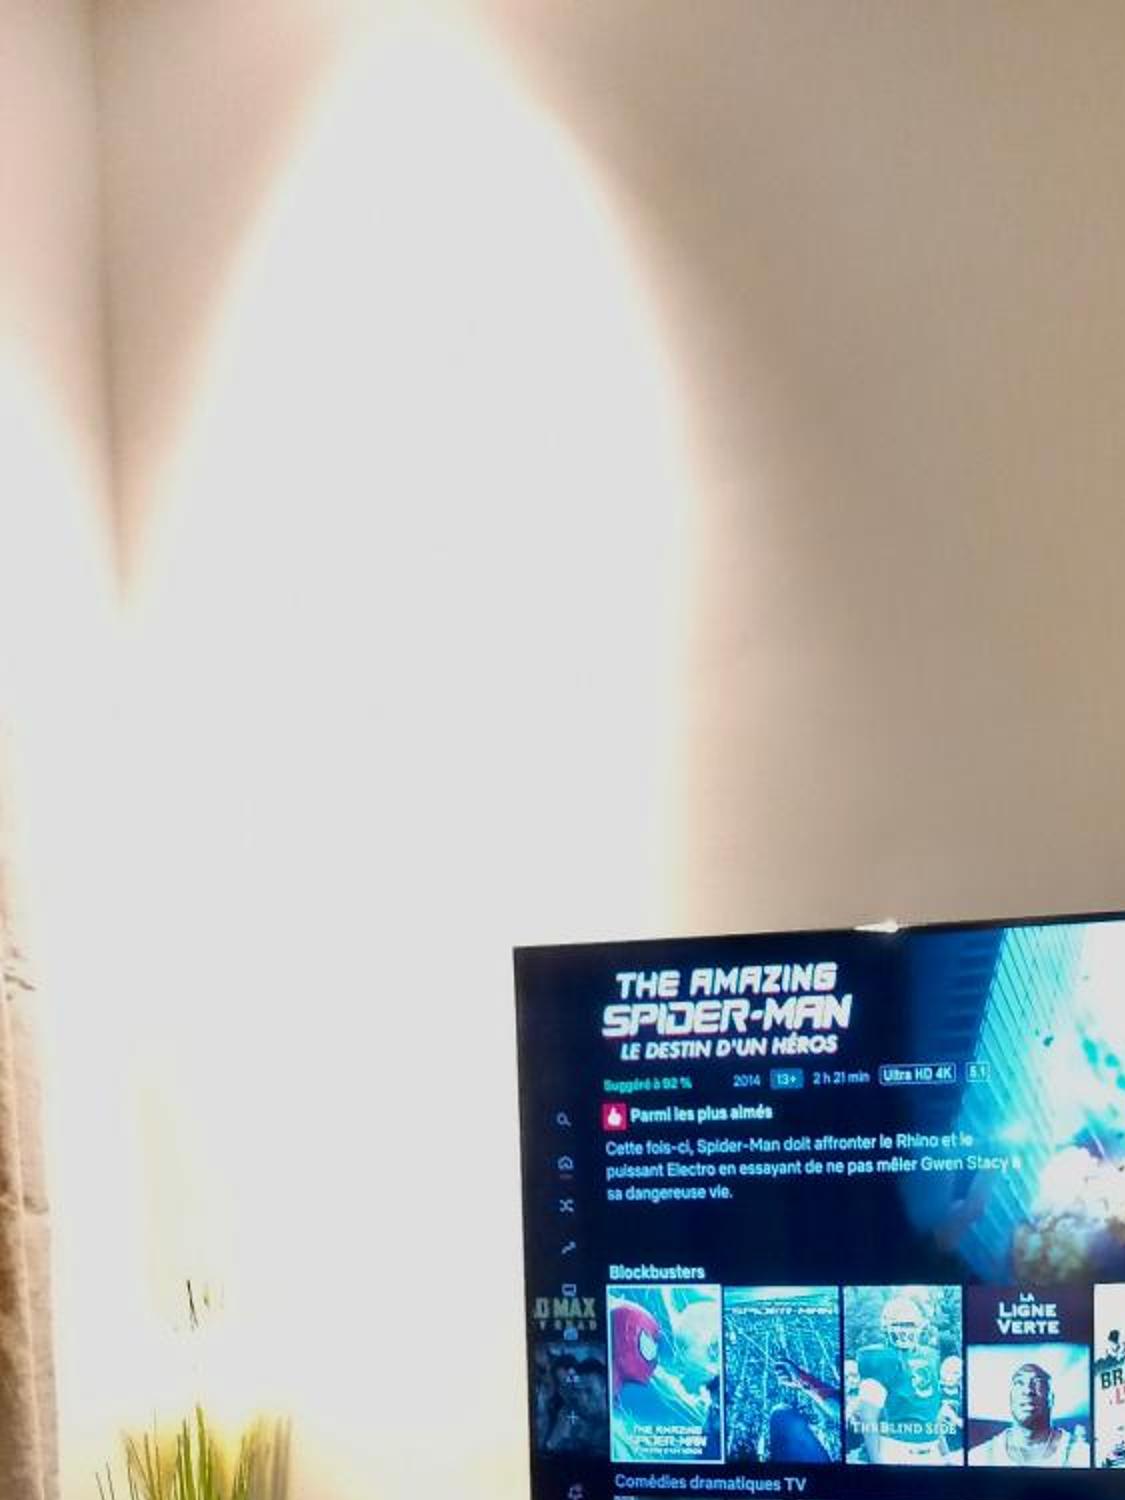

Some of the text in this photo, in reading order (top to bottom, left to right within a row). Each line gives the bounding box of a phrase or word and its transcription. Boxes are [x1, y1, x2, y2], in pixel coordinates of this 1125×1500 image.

[616, 962, 838, 999] THE AMAZING
[602, 994, 852, 1037] SPIDER-MAN
[621, 1031, 838, 1060] LE DESTIN D'UN HÉROS
[733, 1073, 761, 1088] 2014
[776, 1073, 797, 1085] 13+
[848, 1069, 871, 1083] min
[883, 1068, 912, 1082] Ultra
[915, 1067, 933, 1081] HD
[935, 1066, 952, 1080] 4K
[630, 1103, 773, 1124] Parmi les plus aimés
[605, 1141, 643, 1156] Cette
[697, 1137, 781, 1156] Spider-Man
[783, 1136, 811, 1151] doit
[814, 1134, 876, 1151] affronter
[879, 1132, 892, 1149] le
[896, 1133, 939, 1149] Rhino
[941, 1133, 957, 1148] et
[960, 1131, 973, 1147] le
[606, 1163, 664, 1181] puissant
[667, 1161, 716, 1178] Electro
[718, 1163, 737, 1176] en
[740, 1160, 802, 1178] essayant
[804, 1158, 823, 1175] de
[825, 1161, 845, 1174] ne
[847, 1160, 874, 1178] pas
[876, 1156, 918, 1173] mêler
[920, 1156, 963, 1171] Gwen
[966, 1154, 1009, 1174] Stacy
[607, 1183, 733, 1204] sa dangereuse vie.
[609, 1264, 706, 1280] Blockbusters
[553, 1297, 596, 1318] MAX
[1020, 1293, 1035, 1303] LA
[999, 1302, 1057, 1318] LIGNE
[997, 1319, 1060, 1335] VERTE
[880, 1420, 923, 1434] BLIND
[615, 1474, 807, 1494] Comédies dramatiques TV
